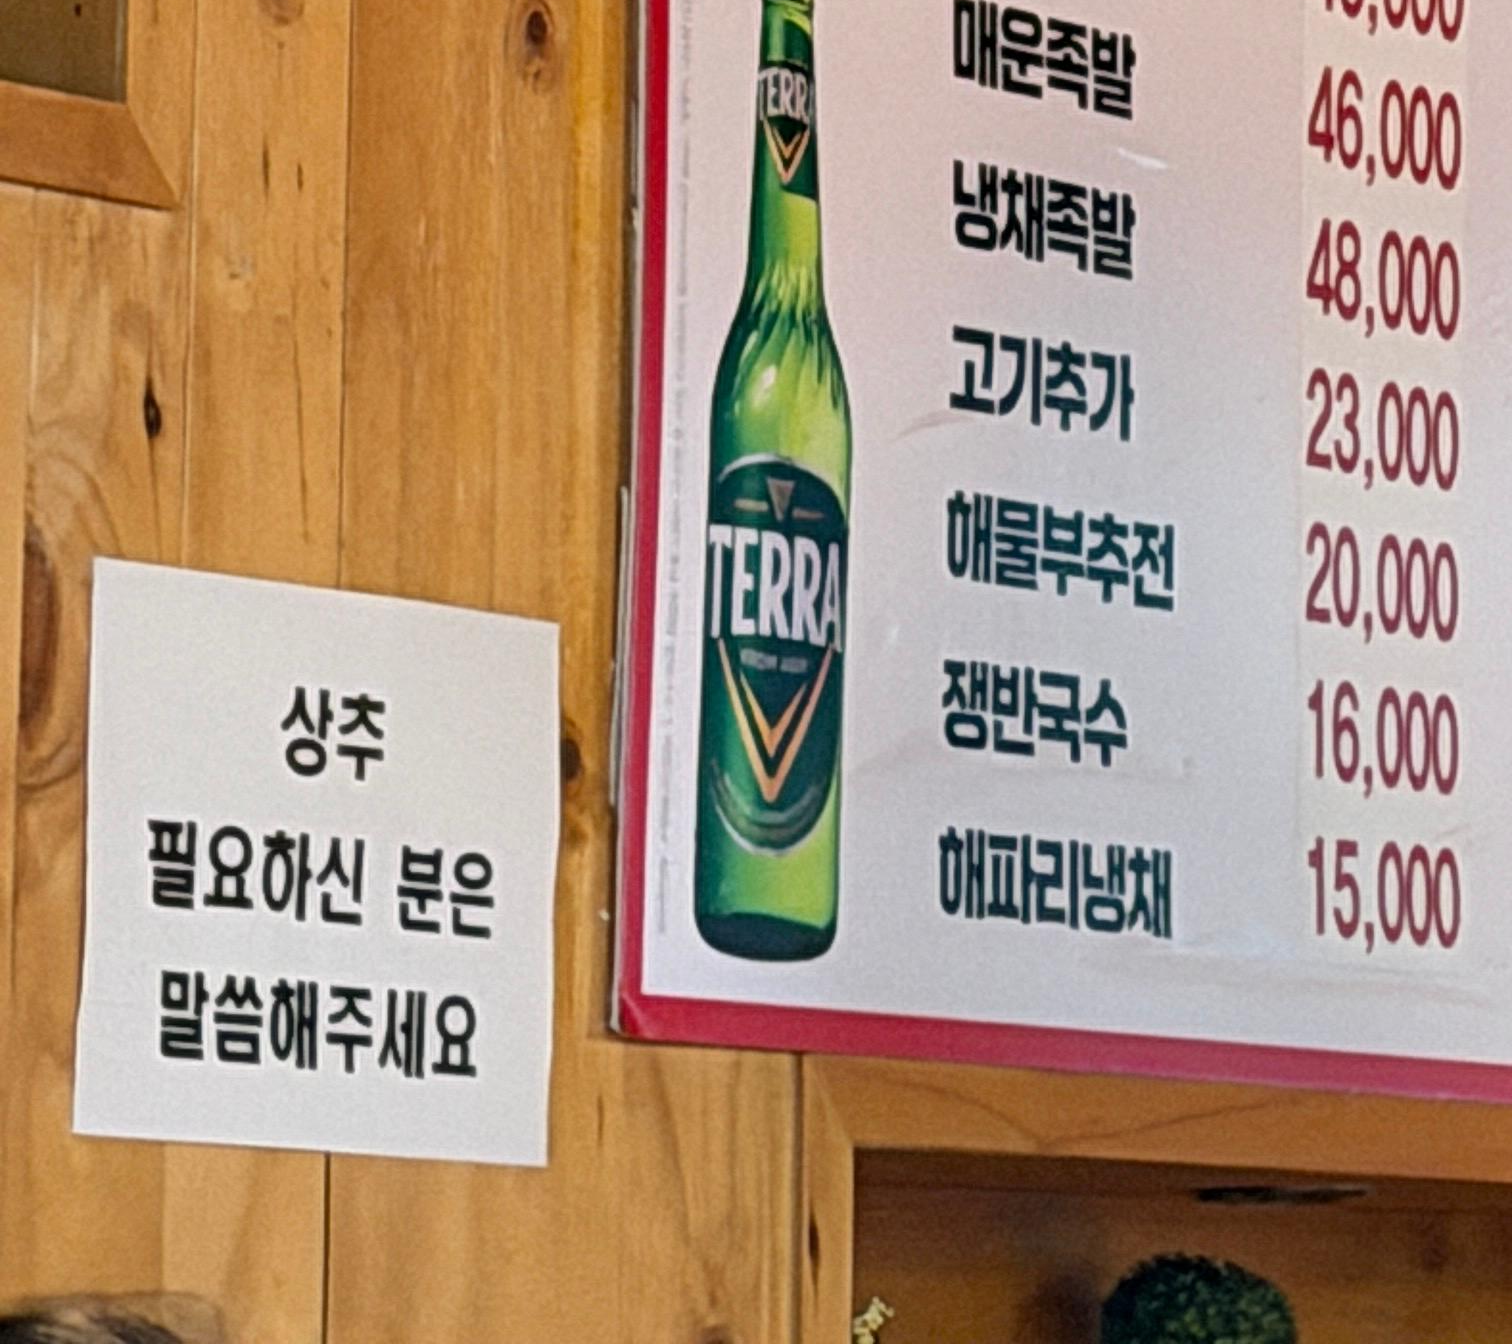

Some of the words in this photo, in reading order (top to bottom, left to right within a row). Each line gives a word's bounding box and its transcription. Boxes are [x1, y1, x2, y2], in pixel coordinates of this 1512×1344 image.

[1307, 67, 1462, 189] 46,000
[953, 161, 1135, 280] 냉채족발
[1306, 220, 1460, 339] 48,000
[949, 326, 1134, 441] 고기추가
[1306, 369, 1460, 491] 23,000
[709, 524, 842, 653] TERRA
[947, 491, 1175, 611] 해물부추전
[1305, 523, 1459, 642] 20,000
[281, 686, 386, 782] 상추
[942, 660, 1128, 767] 쟁반국수
[1307, 681, 1459, 796] 16,000
[148, 819, 365, 926] 필요하신
[397, 845, 495, 939] 분은
[939, 827, 1173, 939] 해파리냉채
[1307, 837, 1460, 952] 15,000
[158, 970, 478, 1079] 말씀해주세요
